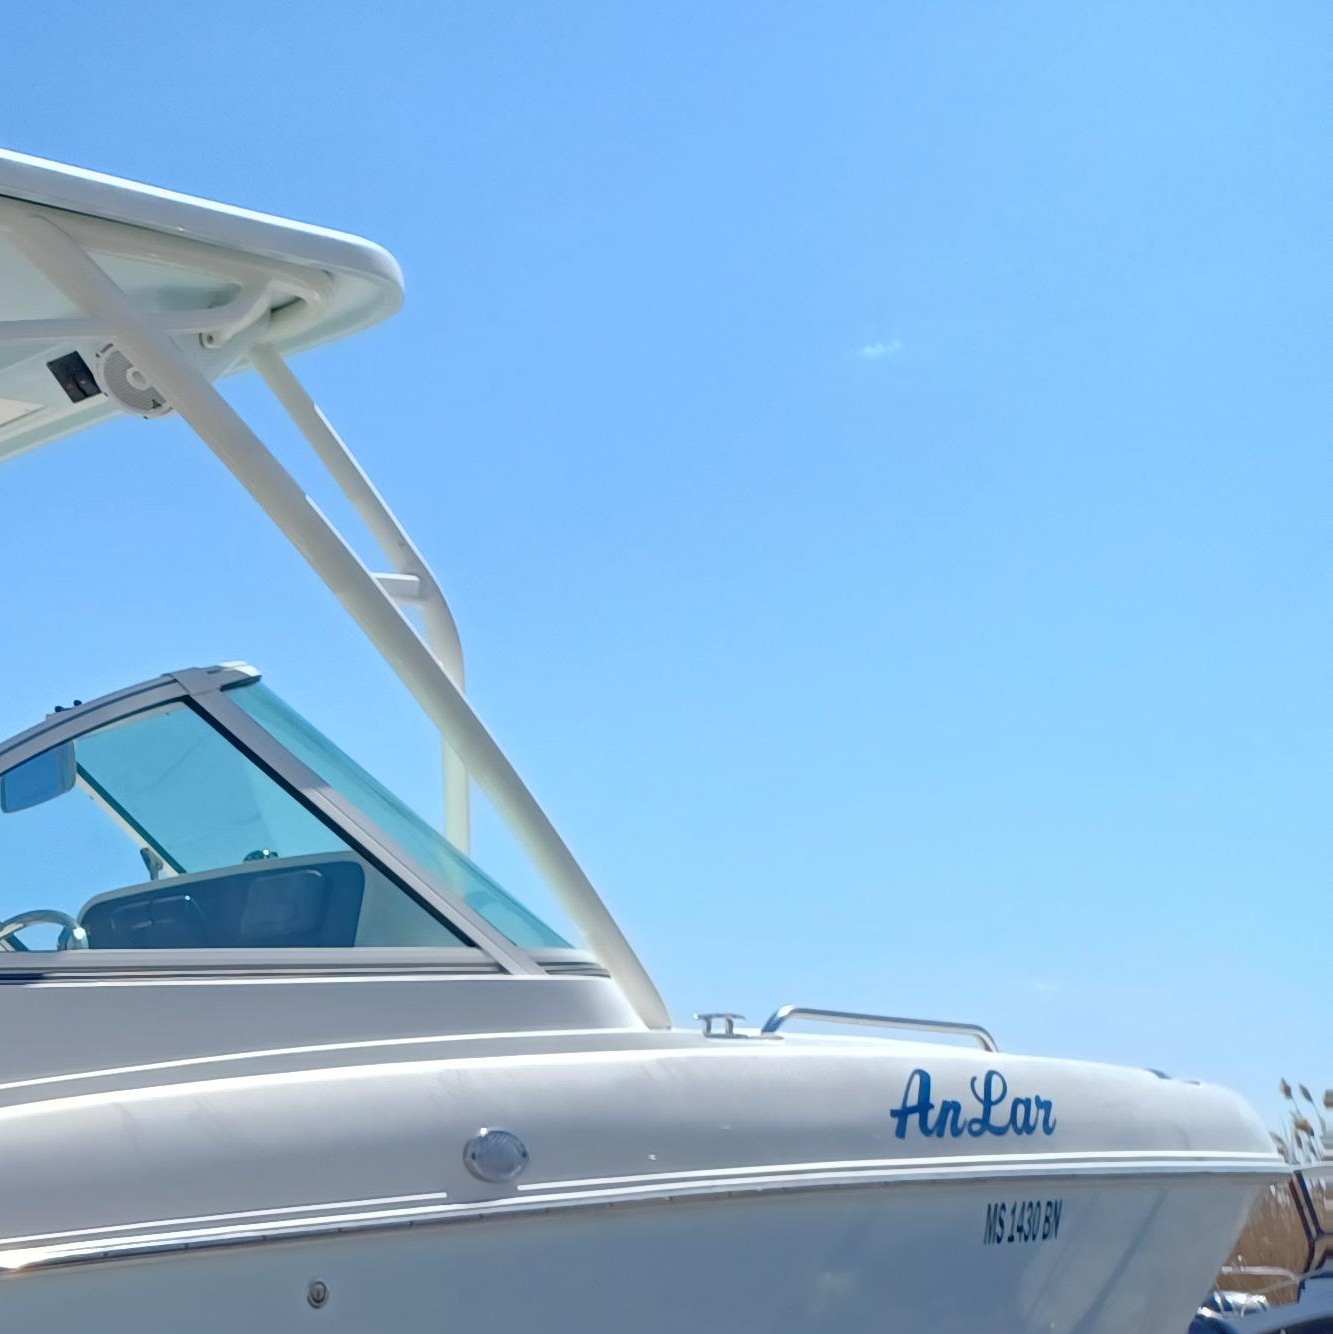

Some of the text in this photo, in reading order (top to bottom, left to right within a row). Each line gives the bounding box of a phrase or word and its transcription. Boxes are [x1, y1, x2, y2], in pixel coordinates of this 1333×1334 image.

[983, 1198, 1063, 1246] MS 1430 BN
